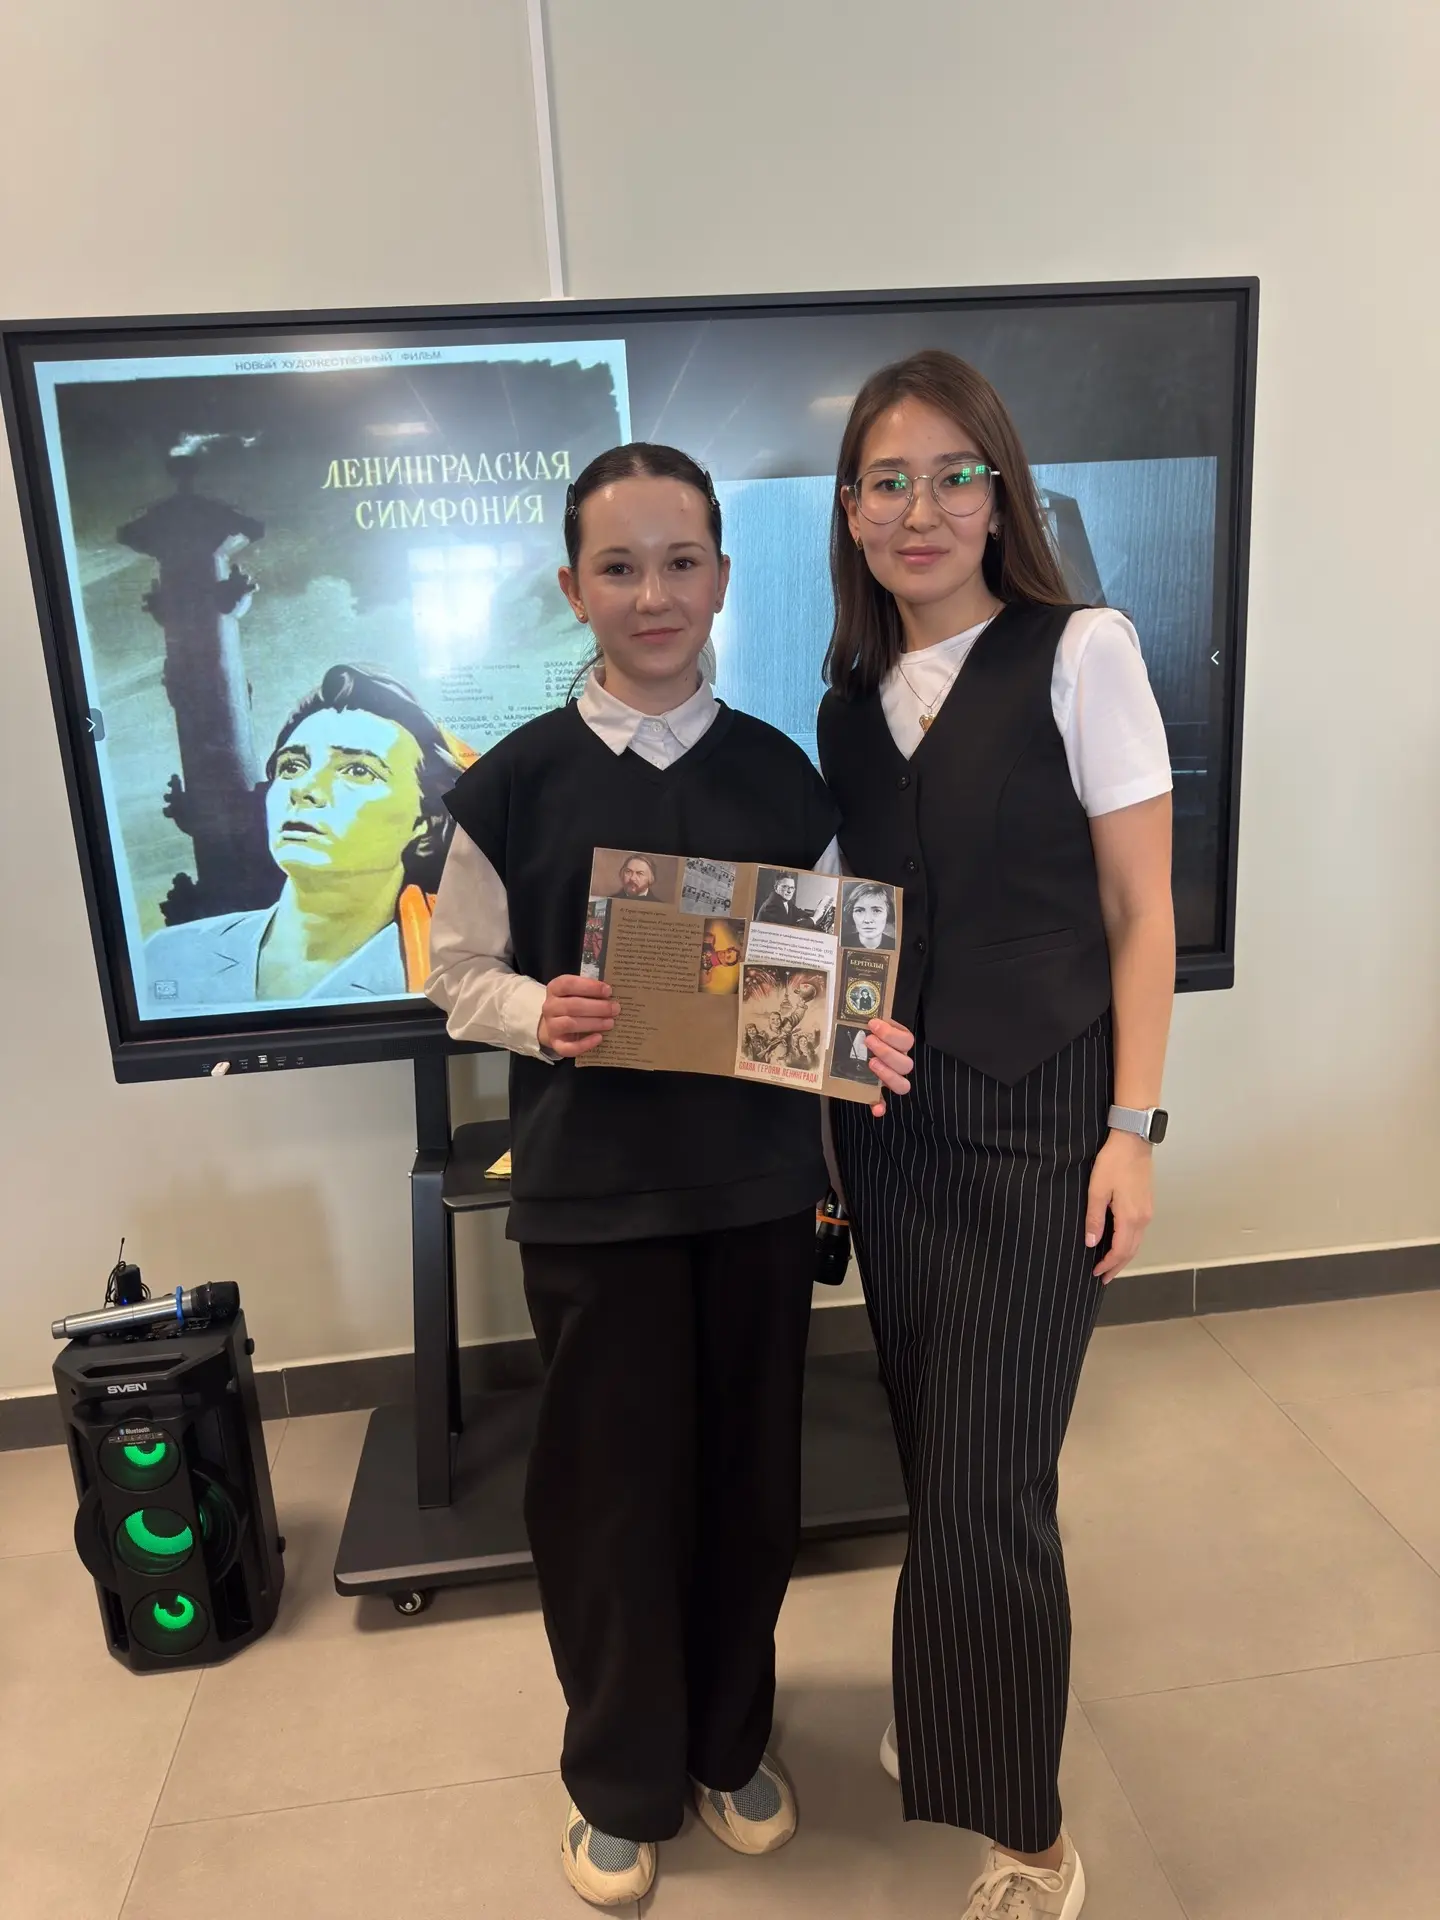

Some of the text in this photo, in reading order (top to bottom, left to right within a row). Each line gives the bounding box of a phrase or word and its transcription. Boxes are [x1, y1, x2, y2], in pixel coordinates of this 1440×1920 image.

[235, 351, 442, 371] НОВЫЙ ХУДОЖЕСТВЕННЫЙ ФИЛЬМ
[320, 450, 572, 489] ЛЕНИНГРАДСКАЯ
[355, 494, 545, 530] СИМФОНИЯ
[107, 1382, 147, 1394] SVEN
[125, 1426, 150, 1435] Bluetooth
